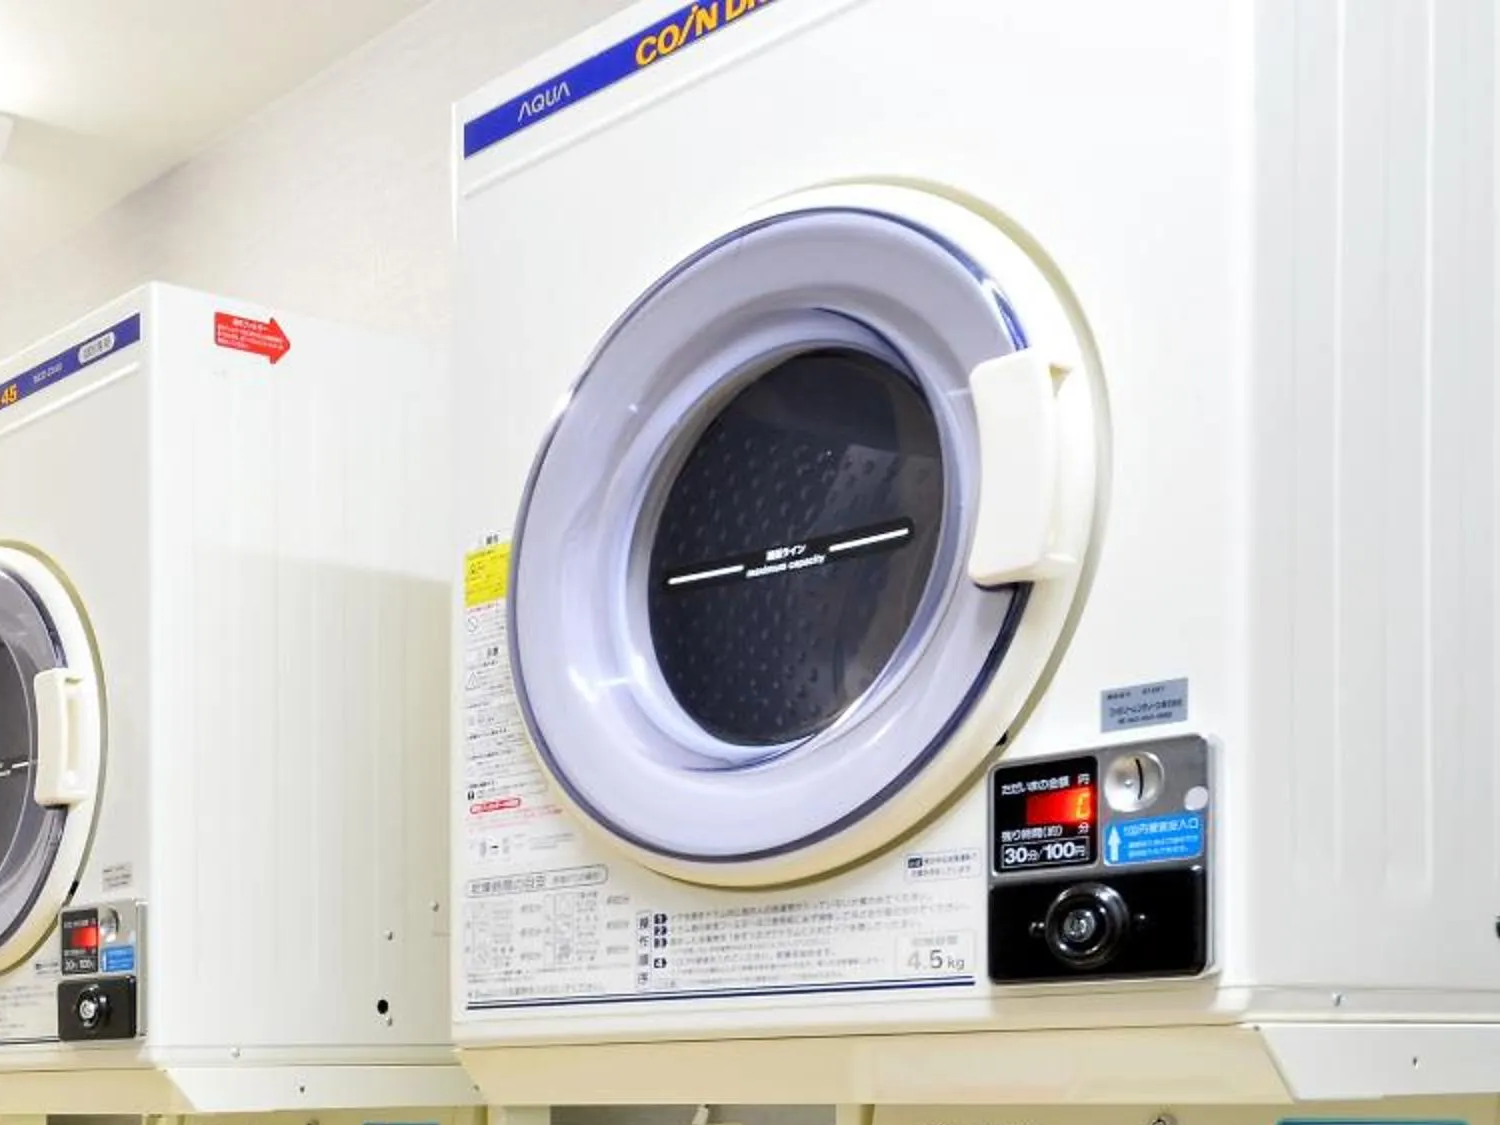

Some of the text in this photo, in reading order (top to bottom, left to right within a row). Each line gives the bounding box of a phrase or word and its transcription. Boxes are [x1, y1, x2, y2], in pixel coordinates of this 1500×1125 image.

[636, 2, 718, 66] COIN
[518, 81, 570, 122] AQUA
[1, 384, 18, 405] 45
[947, 956, 965, 970] kg
